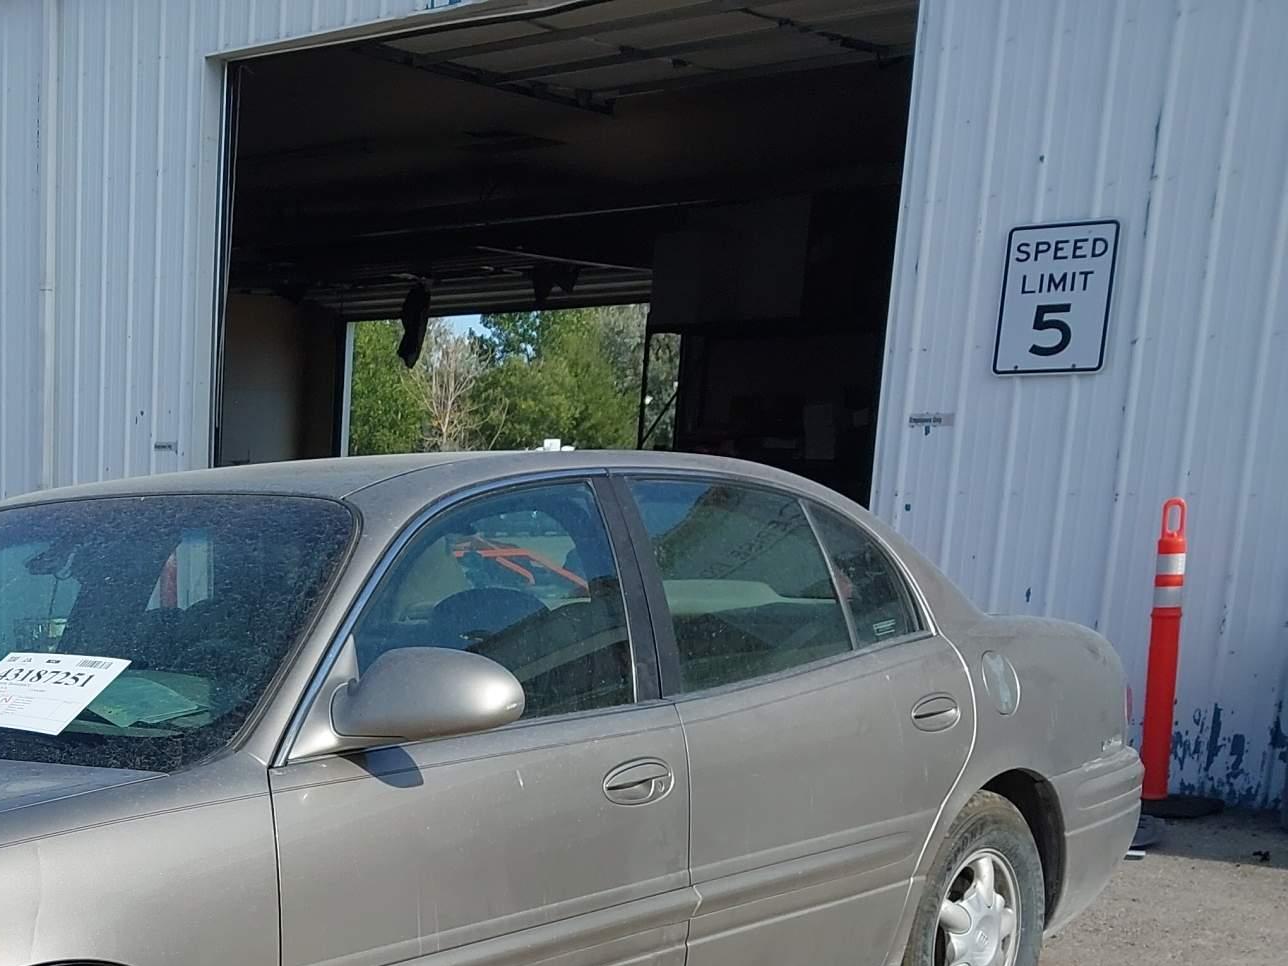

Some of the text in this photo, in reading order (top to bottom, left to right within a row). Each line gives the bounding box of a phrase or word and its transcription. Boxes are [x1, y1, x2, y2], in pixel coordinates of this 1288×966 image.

[1015, 237, 1109, 262] SPEED
[1021, 270, 1094, 294] LIMIT
[1028, 303, 1072, 357] 5
